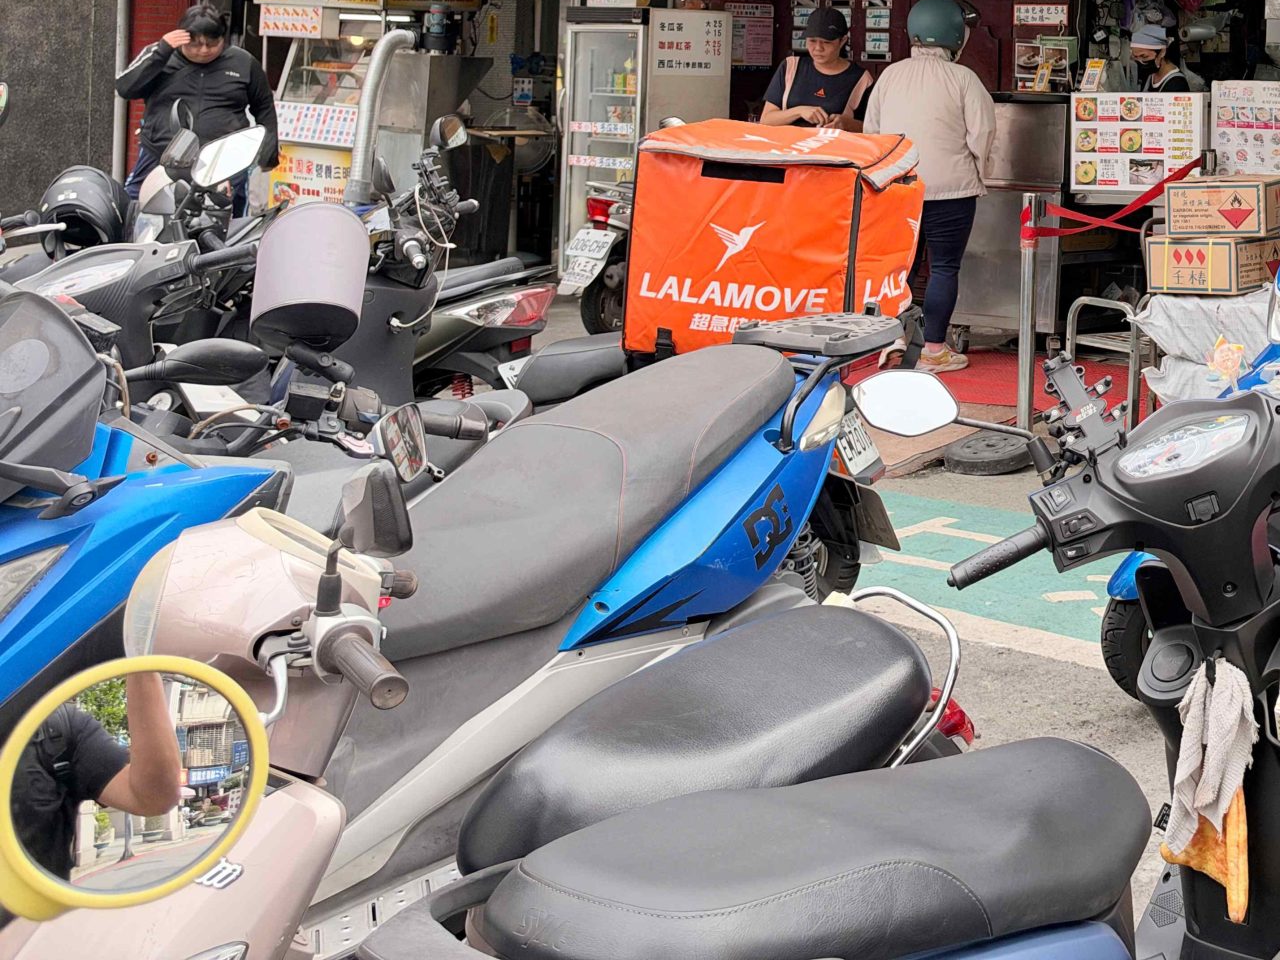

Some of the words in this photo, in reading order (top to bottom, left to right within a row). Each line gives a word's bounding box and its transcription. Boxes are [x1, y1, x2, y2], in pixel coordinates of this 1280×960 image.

[660, 22, 684, 31] 冬瓜茶
[714, 20, 722, 28] 25
[714, 29, 722, 37] 15
[658, 41, 691, 50] 咖啡紅茶
[712, 40, 721, 48] 25
[713, 48, 721, 56] 15
[639, 272, 829, 313] LALAMOVE
